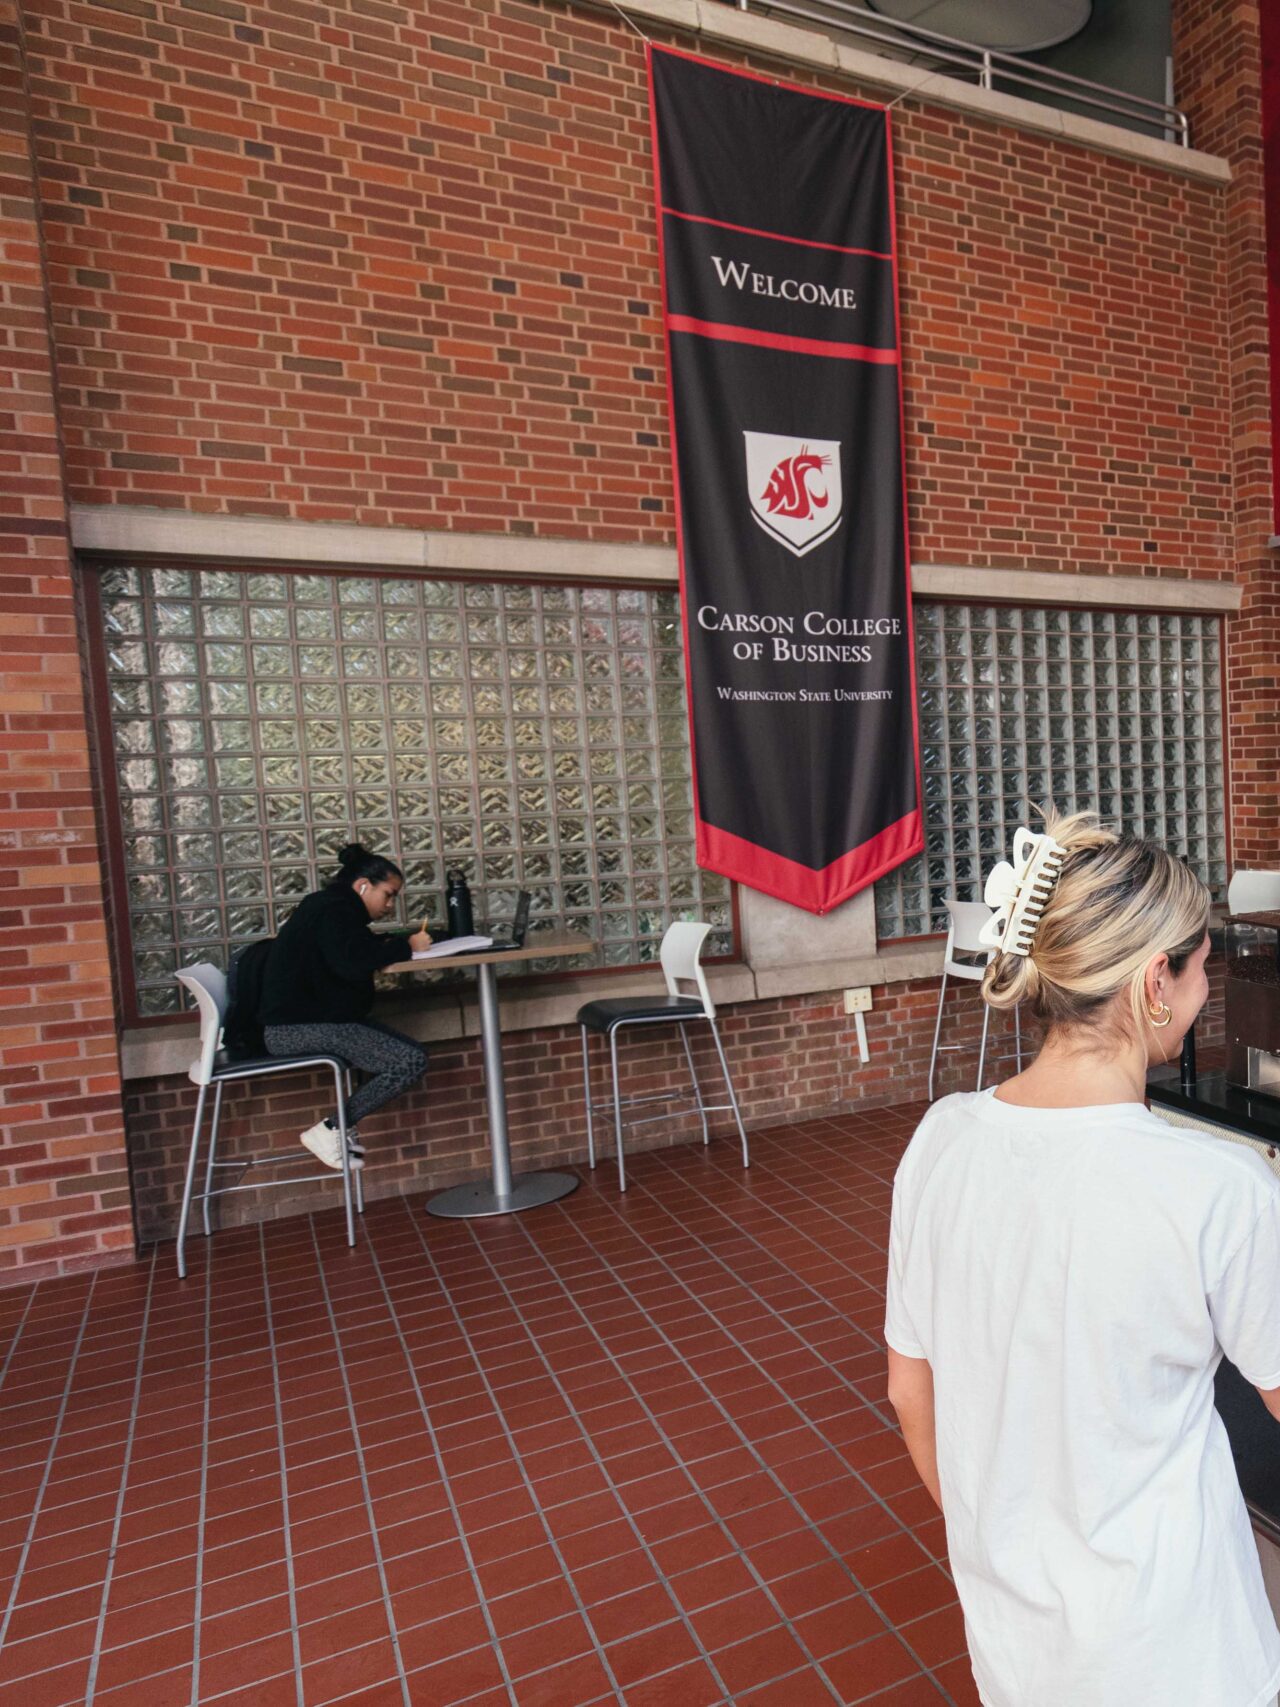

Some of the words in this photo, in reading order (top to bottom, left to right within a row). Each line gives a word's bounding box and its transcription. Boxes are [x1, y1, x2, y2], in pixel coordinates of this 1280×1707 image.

[711, 255, 857, 310] WELCOME
[697, 606, 794, 634] CARSON
[803, 611, 902, 636] COLLEGE
[733, 642, 764, 661] OF
[772, 638, 873, 663] BUSINESS
[717, 686, 796, 701] WASHINGTON
[799, 688, 831, 702] STATE
[834, 689, 893, 702] UNIVERSITY
